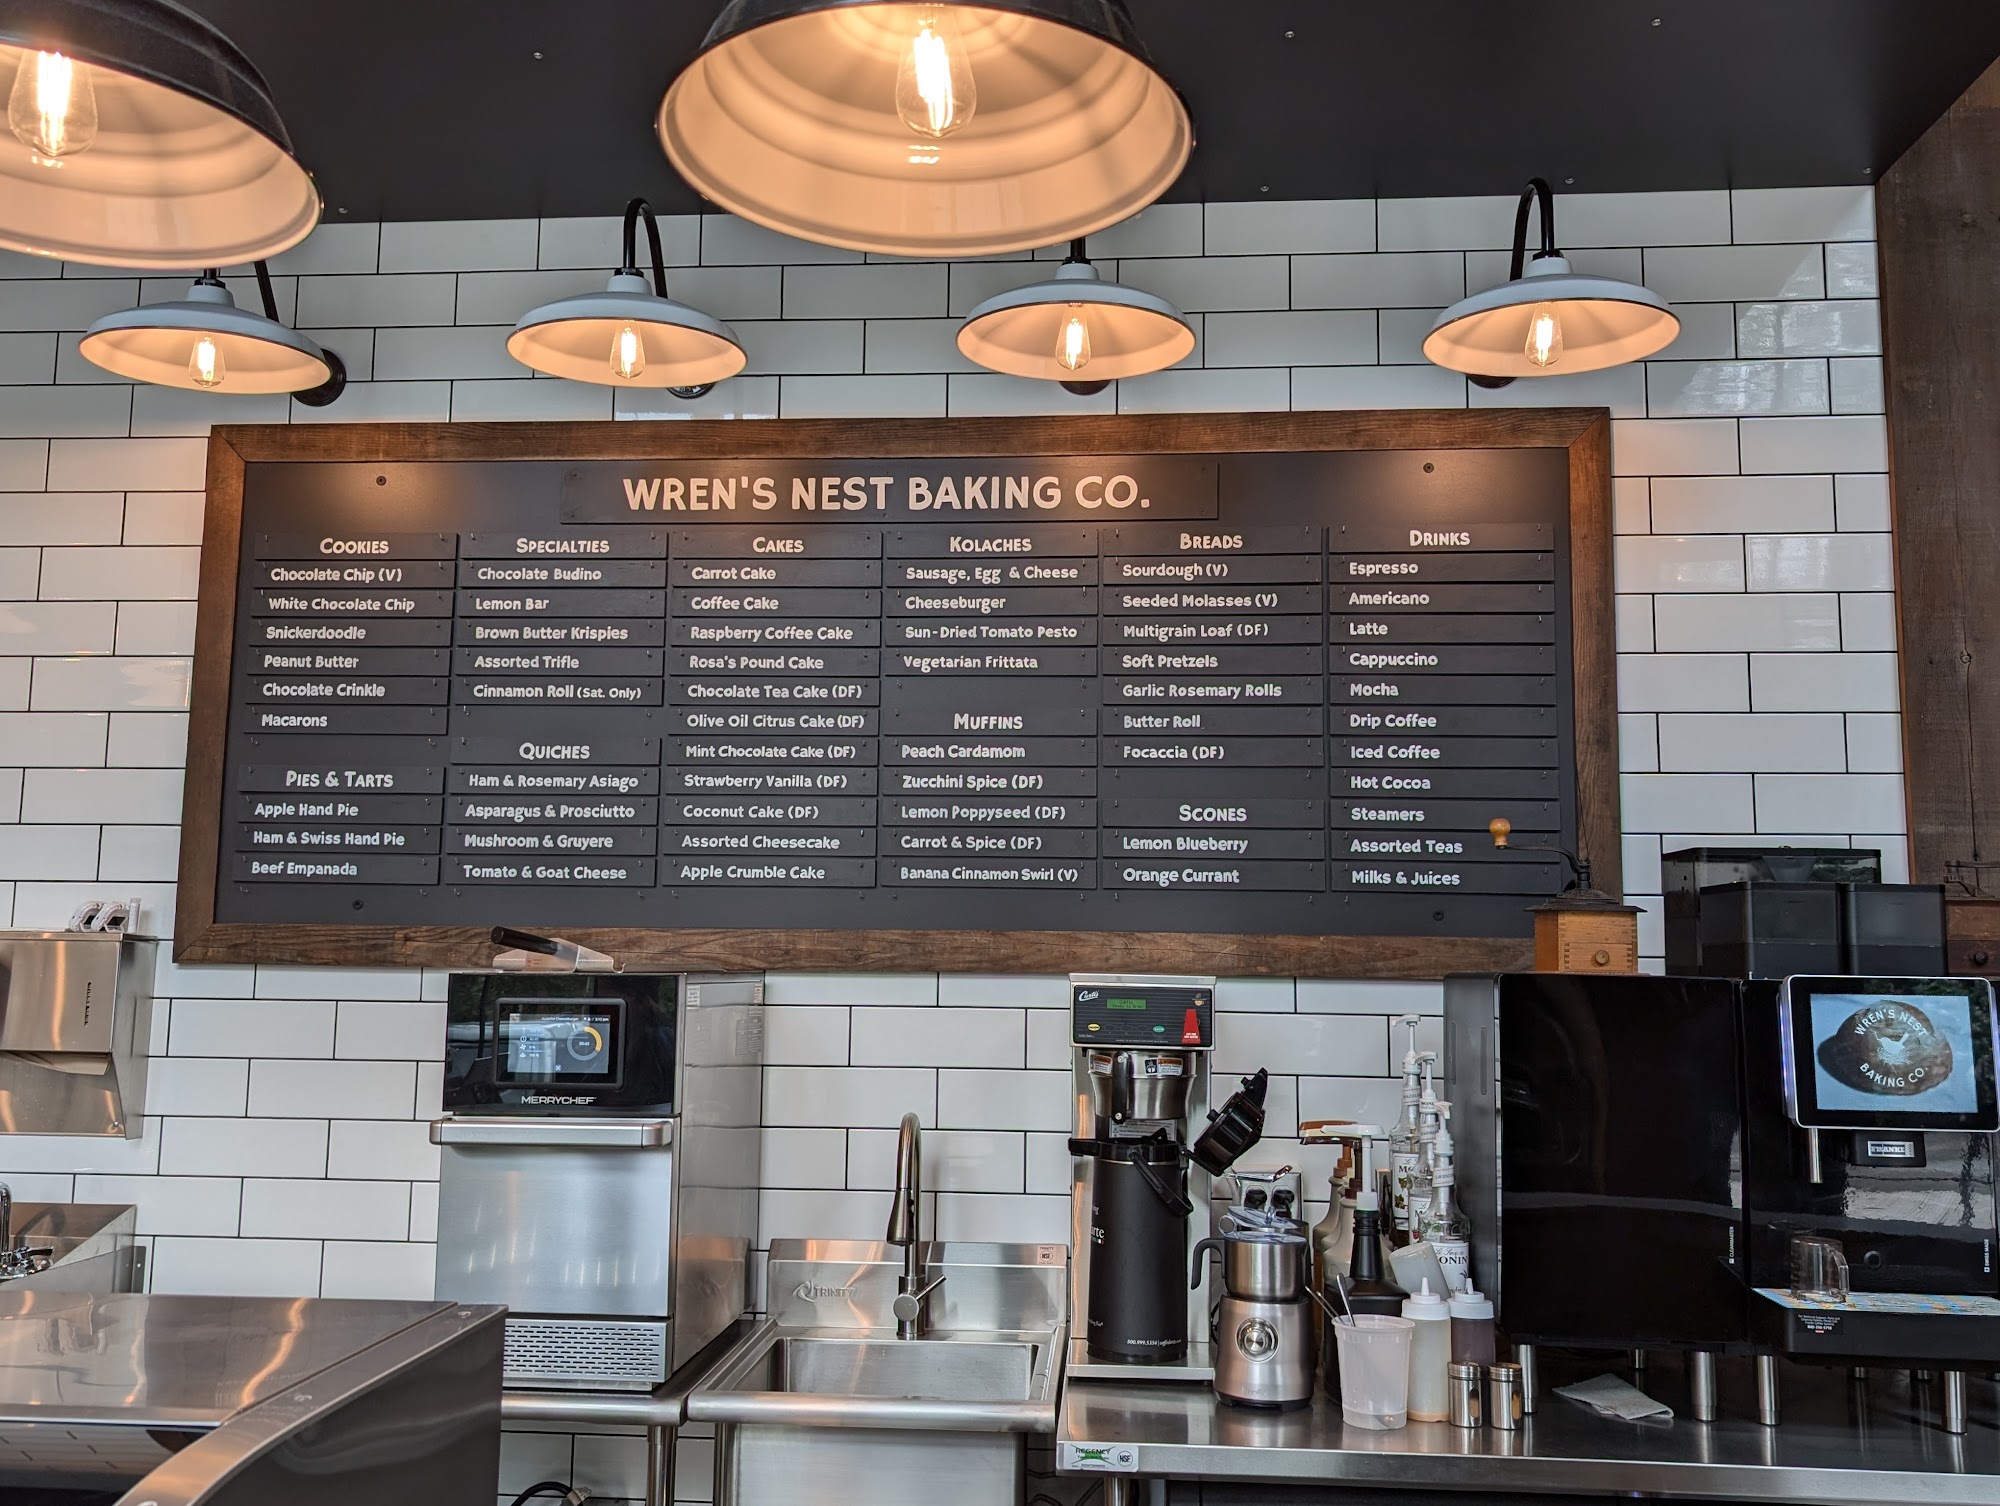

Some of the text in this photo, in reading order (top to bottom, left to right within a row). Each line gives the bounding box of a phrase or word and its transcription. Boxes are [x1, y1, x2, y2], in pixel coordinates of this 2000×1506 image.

[622, 474, 1150, 511] WREN'S NEST BAKING CO.
[319, 537, 390, 555] COOKIES
[516, 537, 610, 554] SPECIALTIES
[752, 536, 805, 553] CAKES
[949, 536, 1032, 553] KOLACHES
[1179, 532, 1243, 550] BREADS
[1409, 529, 1471, 547] DRINKS
[270, 567, 403, 584] Chocolate Chip (V)
[477, 567, 602, 581] Chocolate Budino
[691, 566, 777, 580] Carrot Cake
[906, 565, 1079, 585] Sausage, Egg & Cheese
[1122, 562, 1229, 582] Sourdough (V)
[1349, 562, 1419, 577] Espresso
[268, 596, 416, 614] White Chocolate Chip
[475, 597, 550, 611] Lemon Bar
[905, 595, 1007, 614] Cheeseburger
[1348, 590, 1430, 606] Americano
[266, 625, 367, 640] Snickerdoodle
[475, 625, 629, 642] Brown Butter Krispies
[690, 625, 854, 643] Raspberry Coffee Cake
[979, 625, 1034, 639] Tomato
[1037, 625, 1078, 638] Pesto
[1123, 623, 1269, 643] Multigrain Loaf (DF)
[1349, 622, 1389, 636] Latte
[264, 654, 360, 669] Peanut Butter
[474, 655, 580, 669] Assorted Trifle
[689, 655, 824, 670] Rosa's Pound Cake
[903, 655, 1039, 674] Vegetarian Frittata
[1122, 653, 1219, 668] Soft Pretzels
[1349, 652, 1439, 669] Cappuccino
[262, 682, 386, 697] Chocolate Crinkle
[473, 683, 642, 701] Cinnamon Roll (Sat. Only)
[687, 683, 863, 699] Chocolate Tea Cake (DF)
[1122, 683, 1282, 700] Garlic Rosemary Rolls
[1350, 682, 1399, 697] Mocha
[261, 713, 328, 728] Macarons
[953, 713, 1023, 730] MUFFINS
[1123, 714, 1201, 729] Butter Roll
[1350, 713, 1437, 730] Drip Coffee
[518, 742, 591, 761] QUICHES
[901, 744, 1026, 759] Peach Cardamom
[1123, 745, 1225, 761] Focaccia (DF)
[285, 770, 394, 788] PIES & TARTS
[684, 774, 848, 790] Strawberry Vanilla (DF)
[1350, 775, 1431, 790] Hot Cocoa
[254, 802, 359, 819] Apple Hand Pie
[464, 803, 636, 823] Asparagus & Prosciutto
[901, 805, 1066, 822] Lemon Poppyseed (DF)
[1178, 804, 1248, 822] SCONES
[1351, 807, 1425, 822] Steamers
[464, 833, 614, 851] Mushroom & Gruyere
[681, 834, 841, 850] Assorted Cheesecake
[1123, 836, 1249, 854] Lemon Blueberry
[1350, 838, 1463, 854] Assorted Teas
[251, 860, 358, 878] Beef Empanada
[900, 866, 1078, 883] Banana Cinnamon Swirl (V)
[1122, 867, 1240, 887] Orange Currant
[1351, 869, 1461, 886] Milks & Juices
[1078, 990, 1099, 1002] Curtis
[1854, 1008, 1929, 1037] WREN'S NEST
[1859, 1062, 1929, 1087] BAKING CO.
[521, 1095, 595, 1105] MERRYCHEF
[1437, 1256, 1468, 1265] ONIN
[814, 1286, 855, 1298] TRINITY
[1119, 1454, 1131, 1463] NSF
